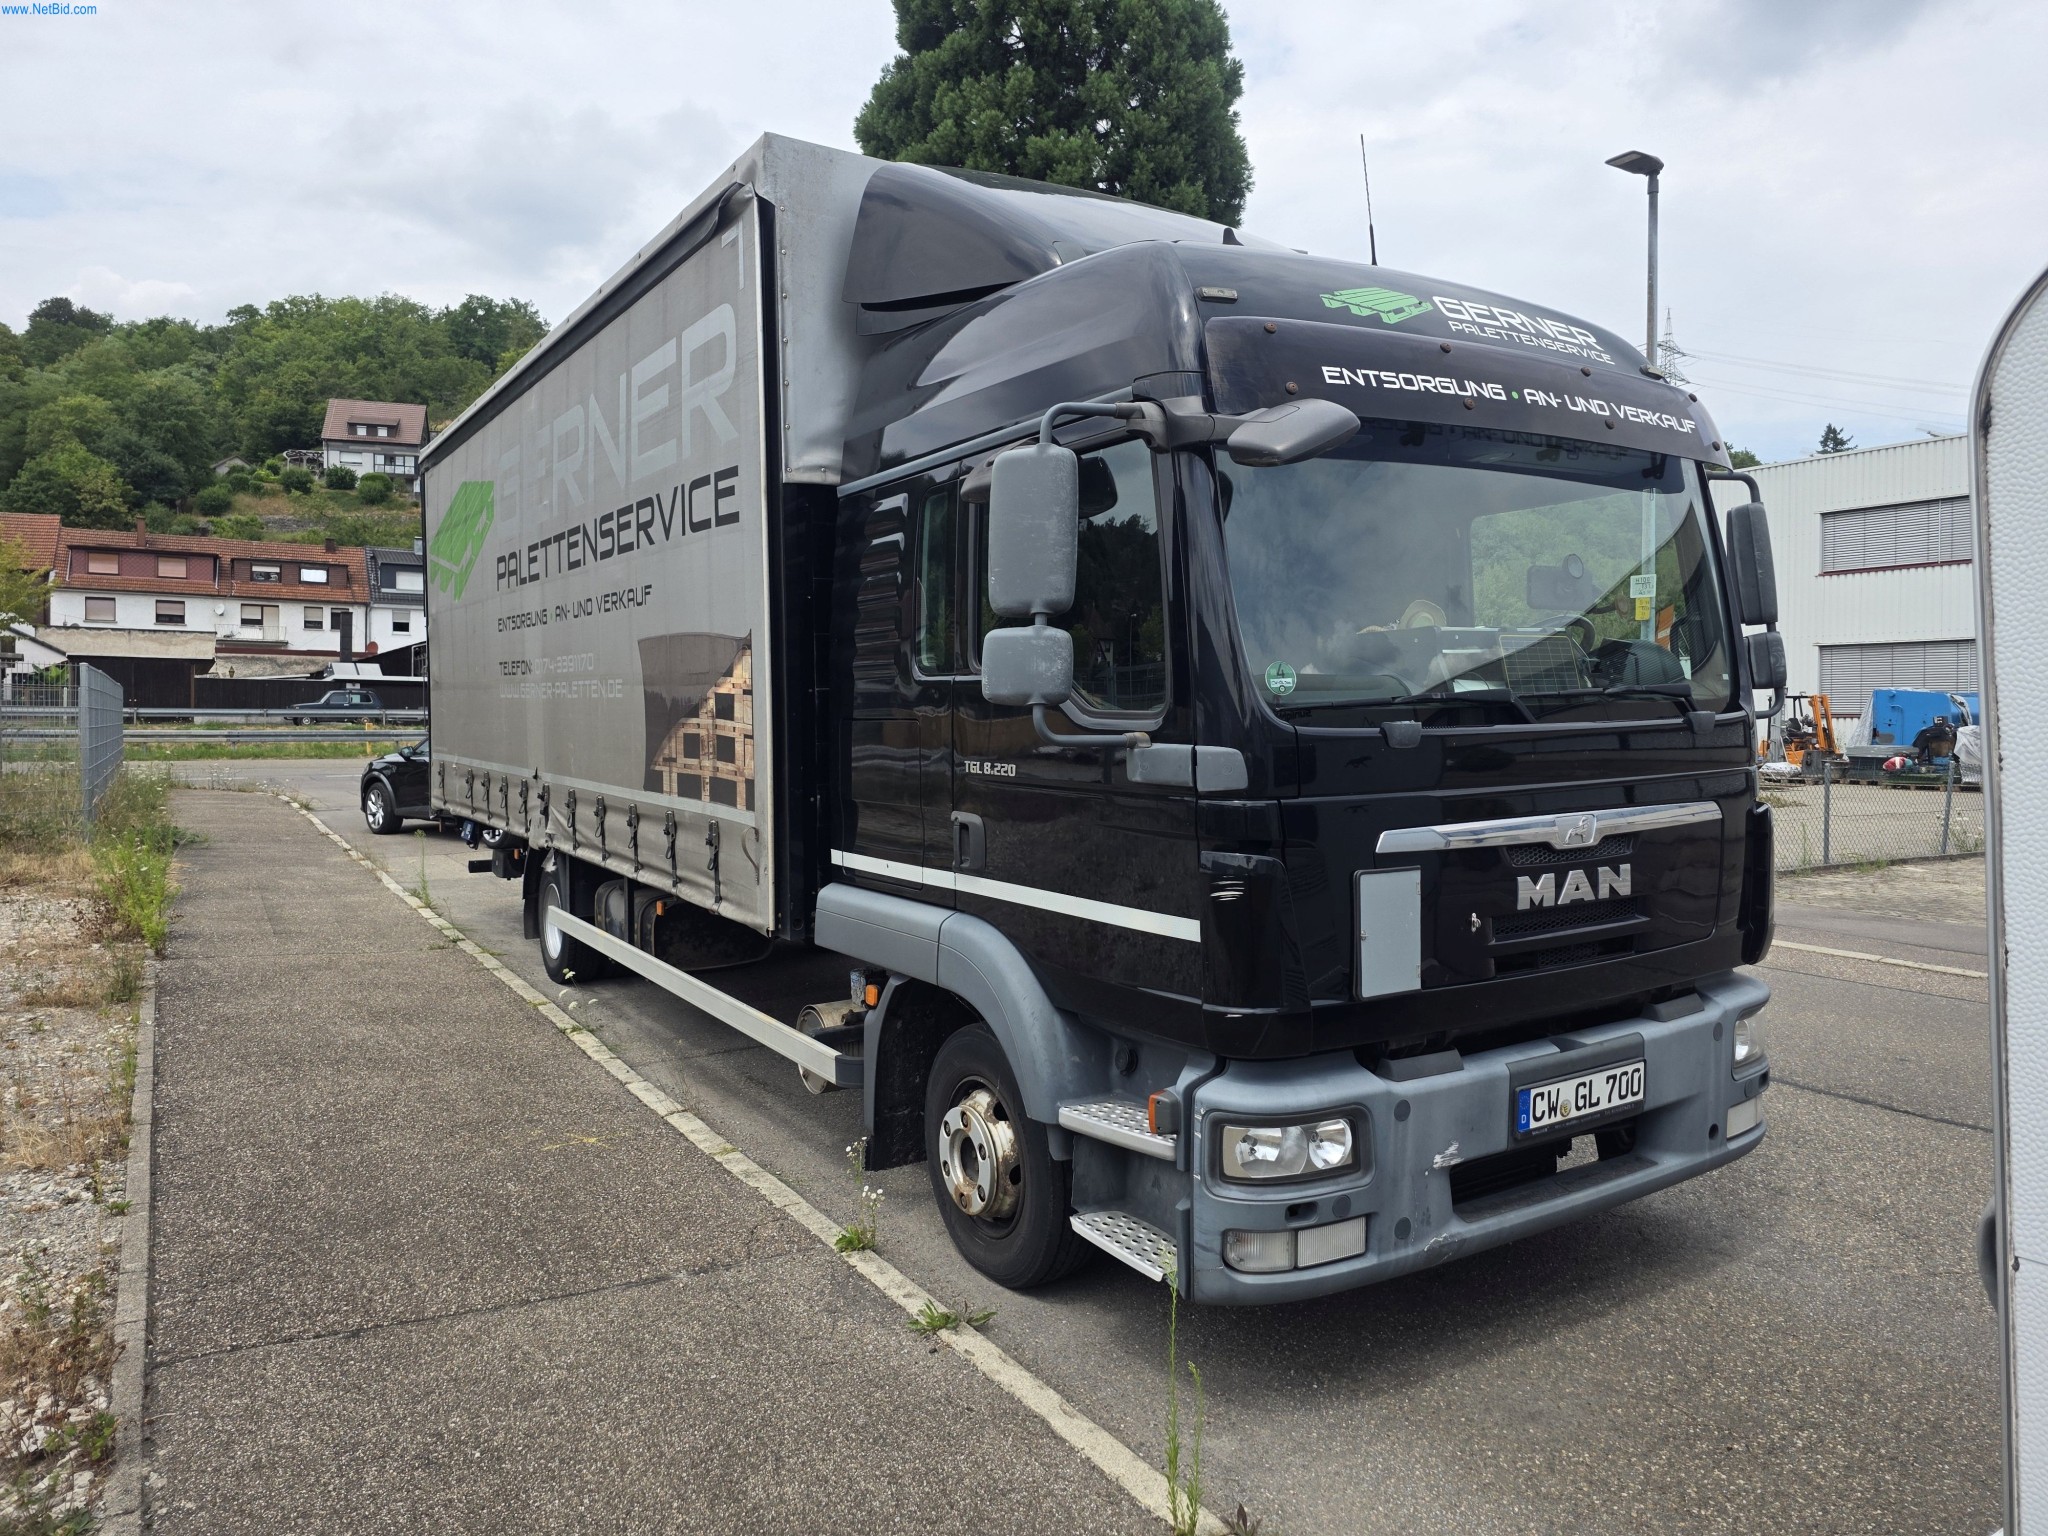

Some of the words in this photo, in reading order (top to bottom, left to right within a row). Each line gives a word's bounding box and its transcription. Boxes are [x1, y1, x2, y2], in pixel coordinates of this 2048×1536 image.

[1432, 296, 1605, 351] GERNER
[1448, 320, 1616, 366] PALETTENSERVICE
[499, 302, 739, 531] GERNER
[1321, 365, 1507, 401] ENTSORGUNG
[1522, 388, 1563, 408] AN-
[1567, 393, 1611, 417] UND
[1610, 402, 1697, 435] VERKAUF
[496, 464, 740, 592] PALETTENSERVICE
[497, 608, 548, 633] ENTSORGUNG
[573, 598, 593, 619] UND
[596, 584, 653, 614] VERKAUF
[499, 660, 533, 676] TELEFON:
[1276, 663, 1285, 678] 4
[964, 760, 982, 774] TGL
[983, 762, 1016, 777] 8.220
[1517, 863, 1631, 910] MAN
[1521, 1114, 1527, 1124] D
[1532, 1087, 1560, 1123] CW
[1574, 1079, 1600, 1112] GL
[1605, 1067, 1642, 1104] 700
